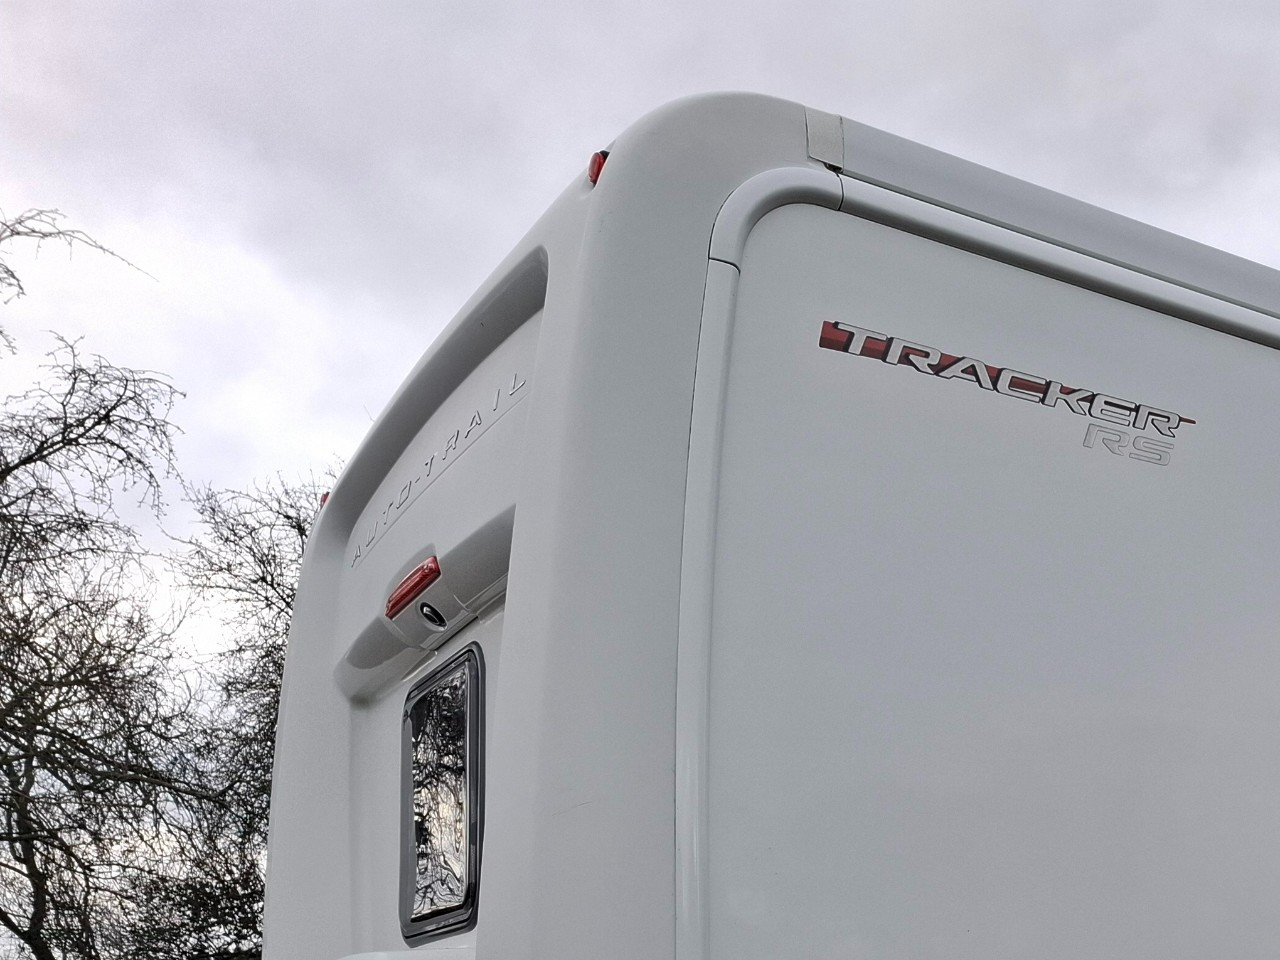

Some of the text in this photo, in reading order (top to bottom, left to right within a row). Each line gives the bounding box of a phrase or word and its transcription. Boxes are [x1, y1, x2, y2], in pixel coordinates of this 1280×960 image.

[836, 321, 1184, 438] TRACKER
[351, 373, 527, 568] AUTO-TRAIL
[1082, 423, 1175, 466] RS
